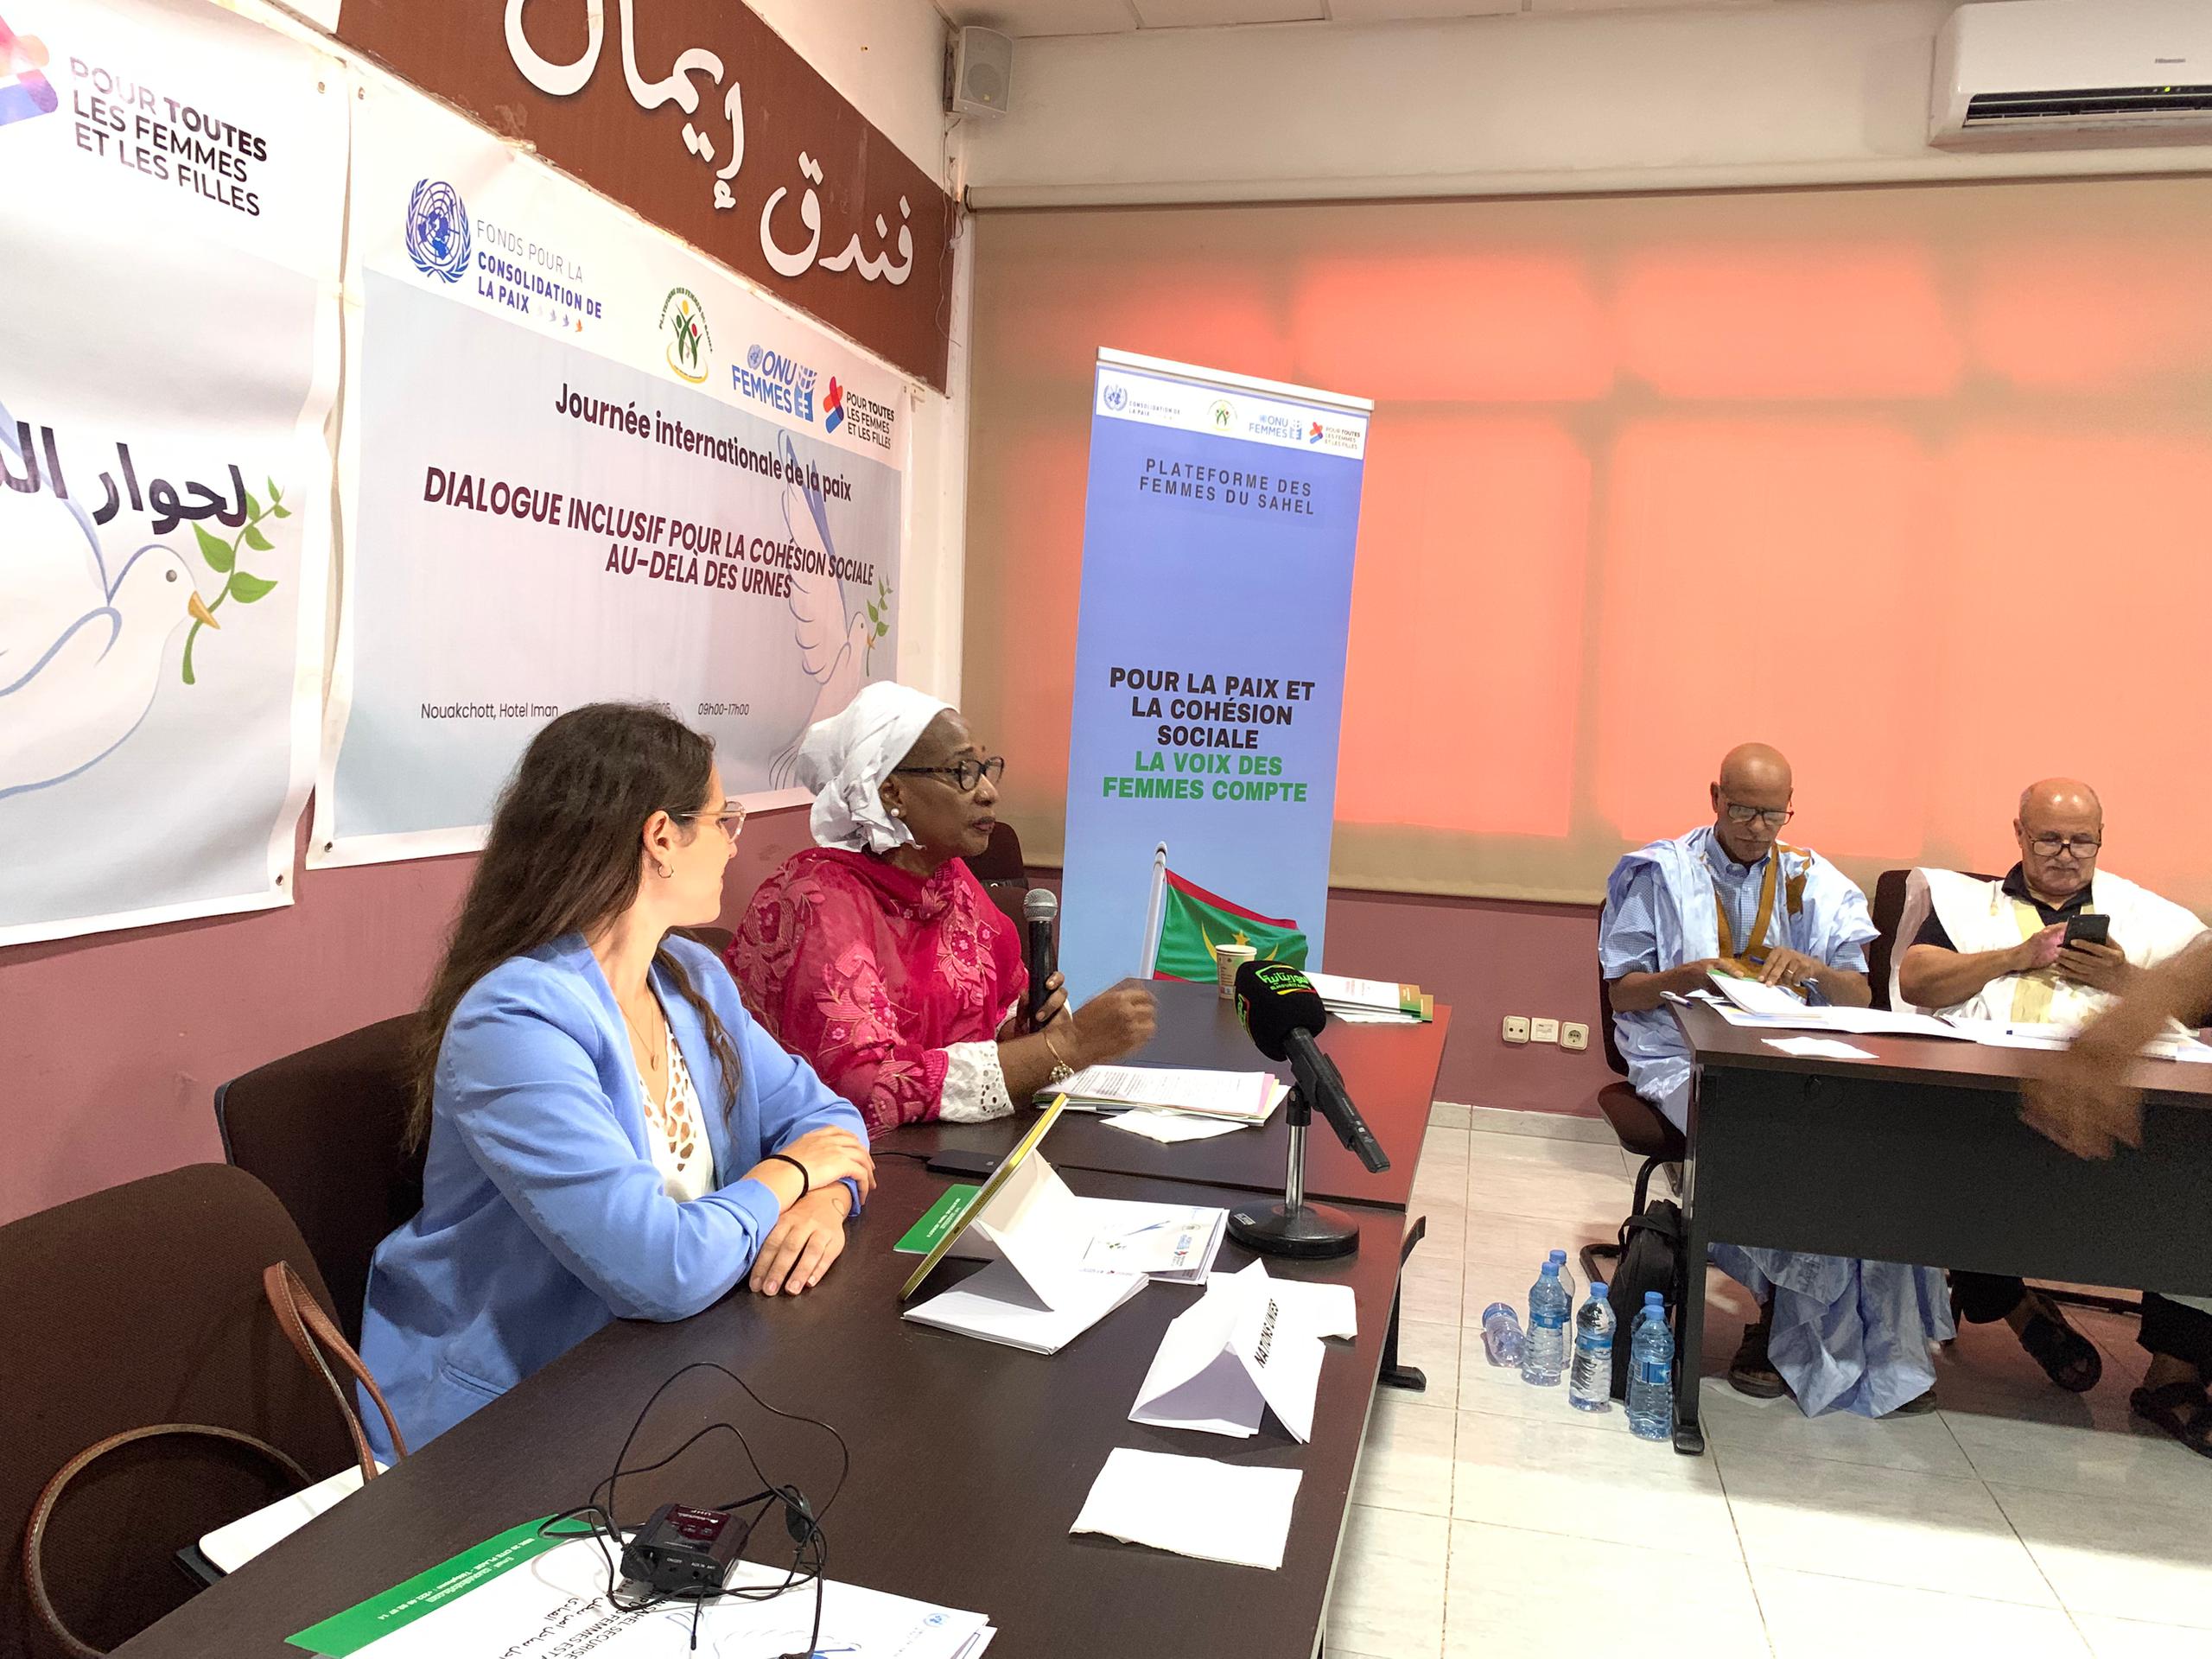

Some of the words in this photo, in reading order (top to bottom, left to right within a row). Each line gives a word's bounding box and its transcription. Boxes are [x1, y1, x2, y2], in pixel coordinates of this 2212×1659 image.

[69, 56, 156, 115] POUR
[163, 97, 267, 162] TOUTES
[73, 90, 126, 132] LES
[136, 115, 247, 182] FEMMES
[75, 122, 109, 156] ET
[119, 140, 168, 180] LES
[177, 163, 260, 217] FILLES
[760, 151, 914, 286] فندق
[477, 219, 524, 257] FONDS
[529, 244, 563, 274] POUR
[569, 262, 583, 283] LA
[478, 251, 582, 311] CONSOLIDATION
[587, 298, 601, 319] DE
[478, 276, 493, 300] LA
[499, 285, 529, 314] PAIX
[761, 351, 798, 386] ONU
[732, 365, 792, 414] FEMMES
[847, 391, 868, 411] POUR
[868, 399, 894, 422] TOUTES
[847, 406, 861, 422] LES
[861, 410, 890, 434] FEMMES
[1129, 401, 1172, 414] CONSOLIDATION
[1268, 415, 1288, 428] ONU
[556, 383, 651, 439] Journée
[656, 410, 783, 480] internationale
[785, 459, 804, 486] de
[806, 464, 819, 492] la
[823, 474, 851, 502] paix
[848, 423, 856, 435] ET
[858, 427, 871, 441] LES
[872, 431, 892, 450] FILLES
[1249, 423, 1287, 439] FEMMES
[1341, 429, 1360, 438] TOUTES
[92, 442, 248, 535] لحوار
[1146, 458, 1269, 491] PLATEFORME
[1278, 476, 1312, 497] DES
[1140, 476, 1216, 501] FEMMES
[1225, 489, 1249, 506] DU
[1258, 494, 1314, 515] SAHEL
[423, 466, 563, 525] DIALOGUE
[568, 498, 665, 543] INCLUSIF
[668, 520, 722, 556] POUR
[725, 532, 744, 560] LA
[750, 537, 826, 575] COHÉSION
[828, 555, 874, 586] SOCIALE
[606, 543, 698, 585] AU-DELÀ
[703, 560, 737, 590] DES
[741, 566, 792, 599] URNES
[1109, 667, 1179, 692] POUR
[1187, 673, 1217, 695] LA
[1224, 676, 1279, 699] PAIX
[1287, 681, 1315, 701] ET
[421, 703, 497, 720] Nouakchott,
[499, 703, 529, 718] Hotel
[531, 703, 559, 717] Iman
[697, 702, 750, 716] 09h00-17h00
[1132, 696, 1162, 718] LA
[1171, 696, 1293, 725] COHÉSION
[1157, 725, 1259, 749] SOCIALE
[1135, 751, 1165, 772] LA
[1173, 753, 1231, 774] VOIX
[1238, 755, 1283, 776] DES
[1103, 777, 1204, 799] FEMMES
[1212, 780, 1308, 802] COMPTE
[1254, 1323, 1273, 1369] NATIONS
[1265, 1298, 1279, 1329] UNIES
[615, 1600, 640, 1616] DS
[569, 1613, 620, 1643] FEMMES
[548, 1642, 574, 1657] EST
